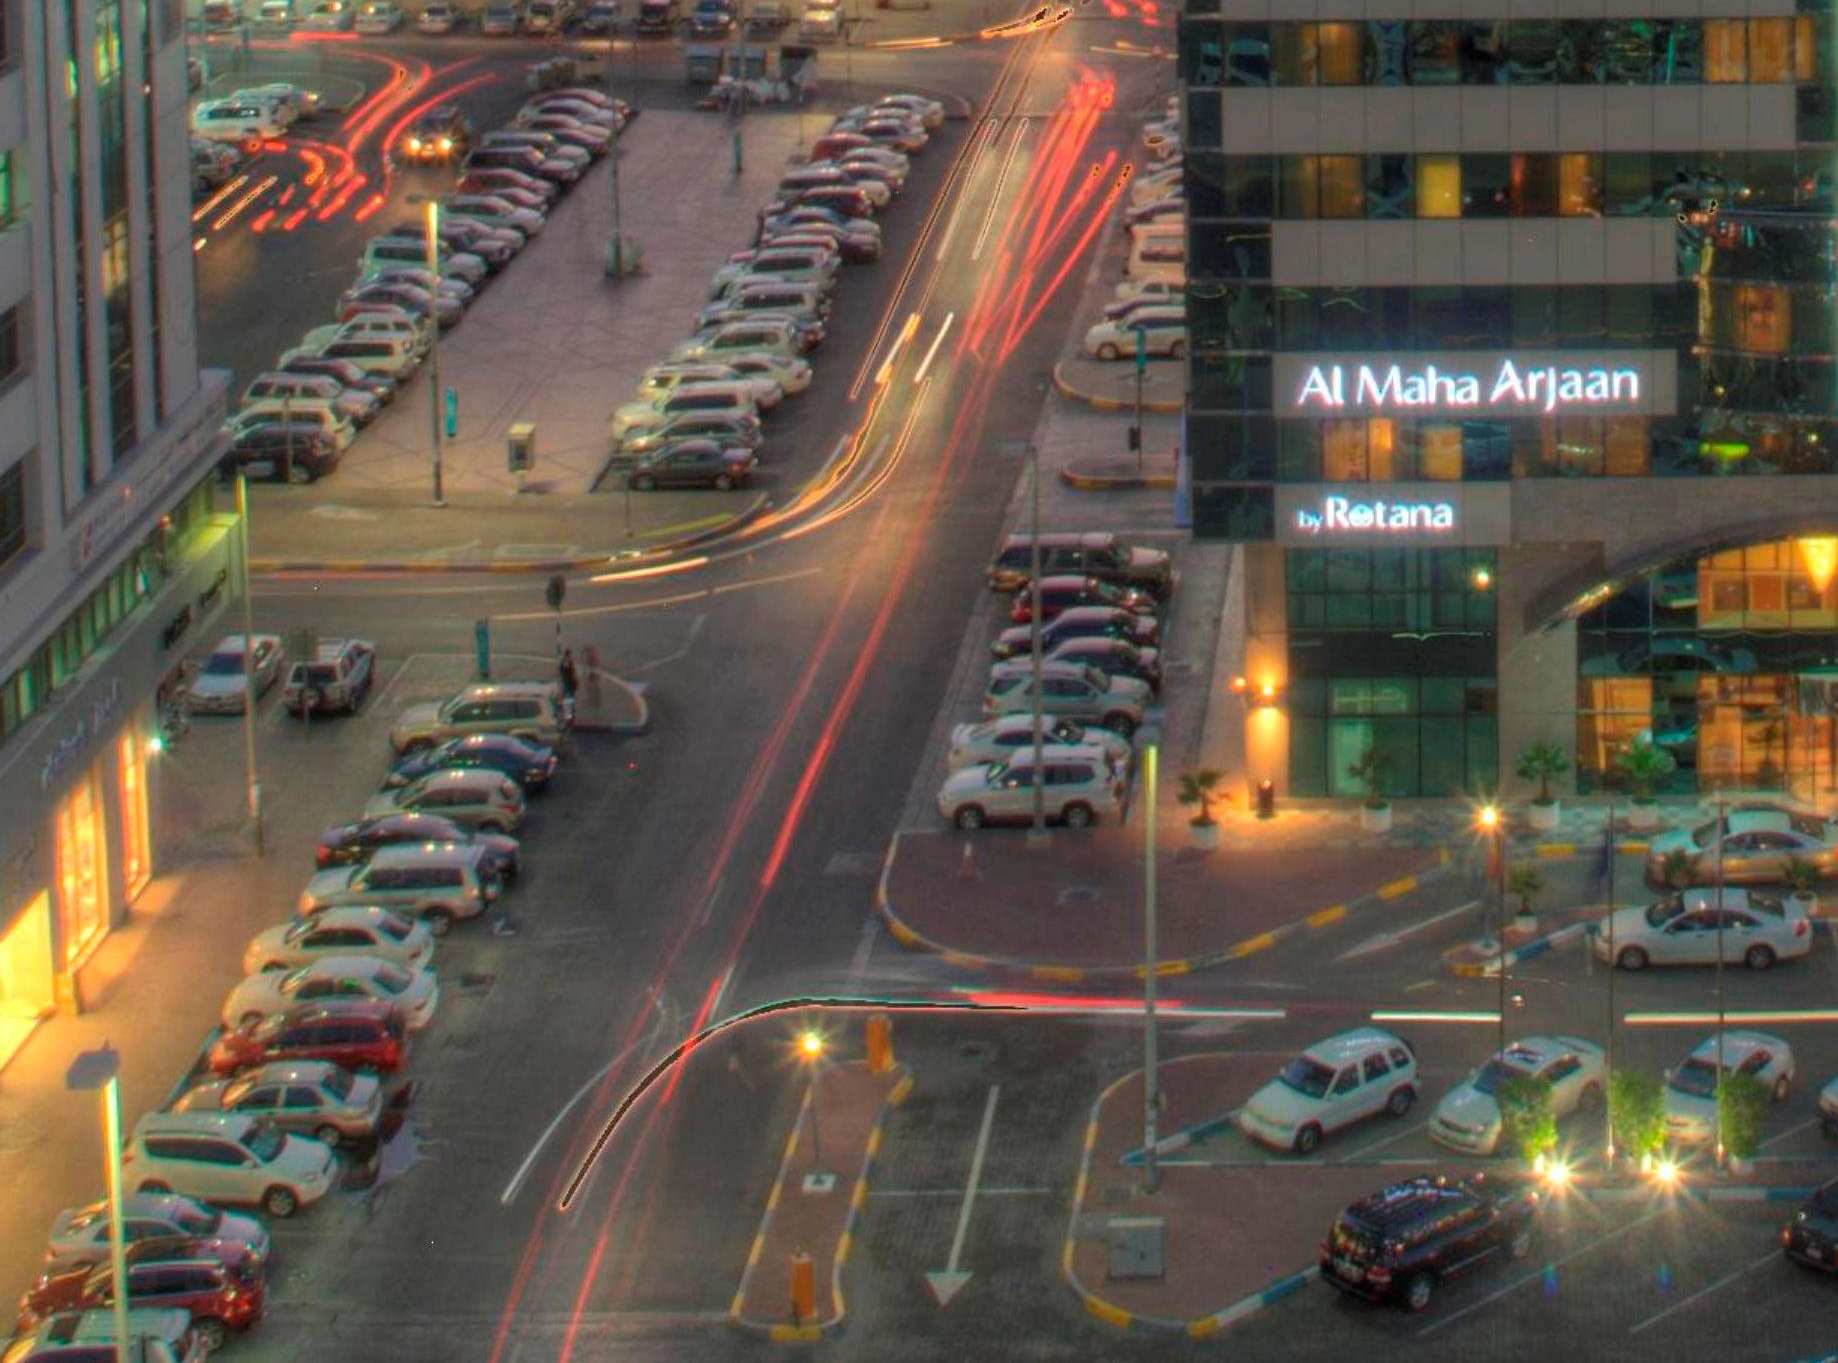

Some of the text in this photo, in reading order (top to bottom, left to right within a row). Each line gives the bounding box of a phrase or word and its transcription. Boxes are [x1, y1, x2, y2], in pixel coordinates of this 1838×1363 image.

[1297, 359, 1640, 412] Al Maha Arjaan
[1297, 495, 1454, 534] by Rotana
